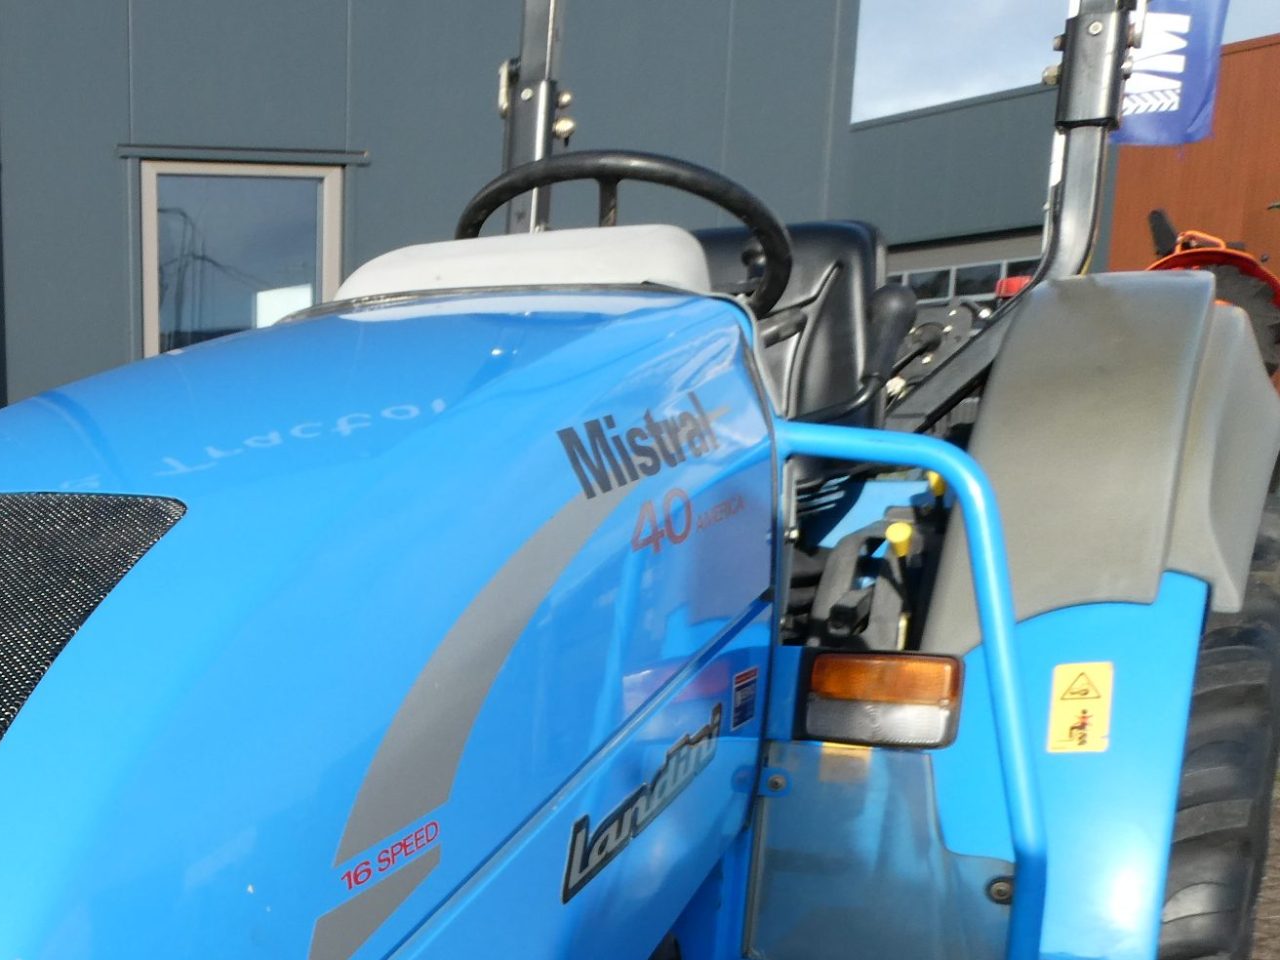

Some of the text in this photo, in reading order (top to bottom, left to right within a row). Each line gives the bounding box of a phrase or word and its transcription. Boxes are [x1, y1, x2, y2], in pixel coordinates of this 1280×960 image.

[556, 391, 718, 499] Mistral
[631, 487, 692, 554] 40
[341, 821, 439, 890] 16 SPEED
